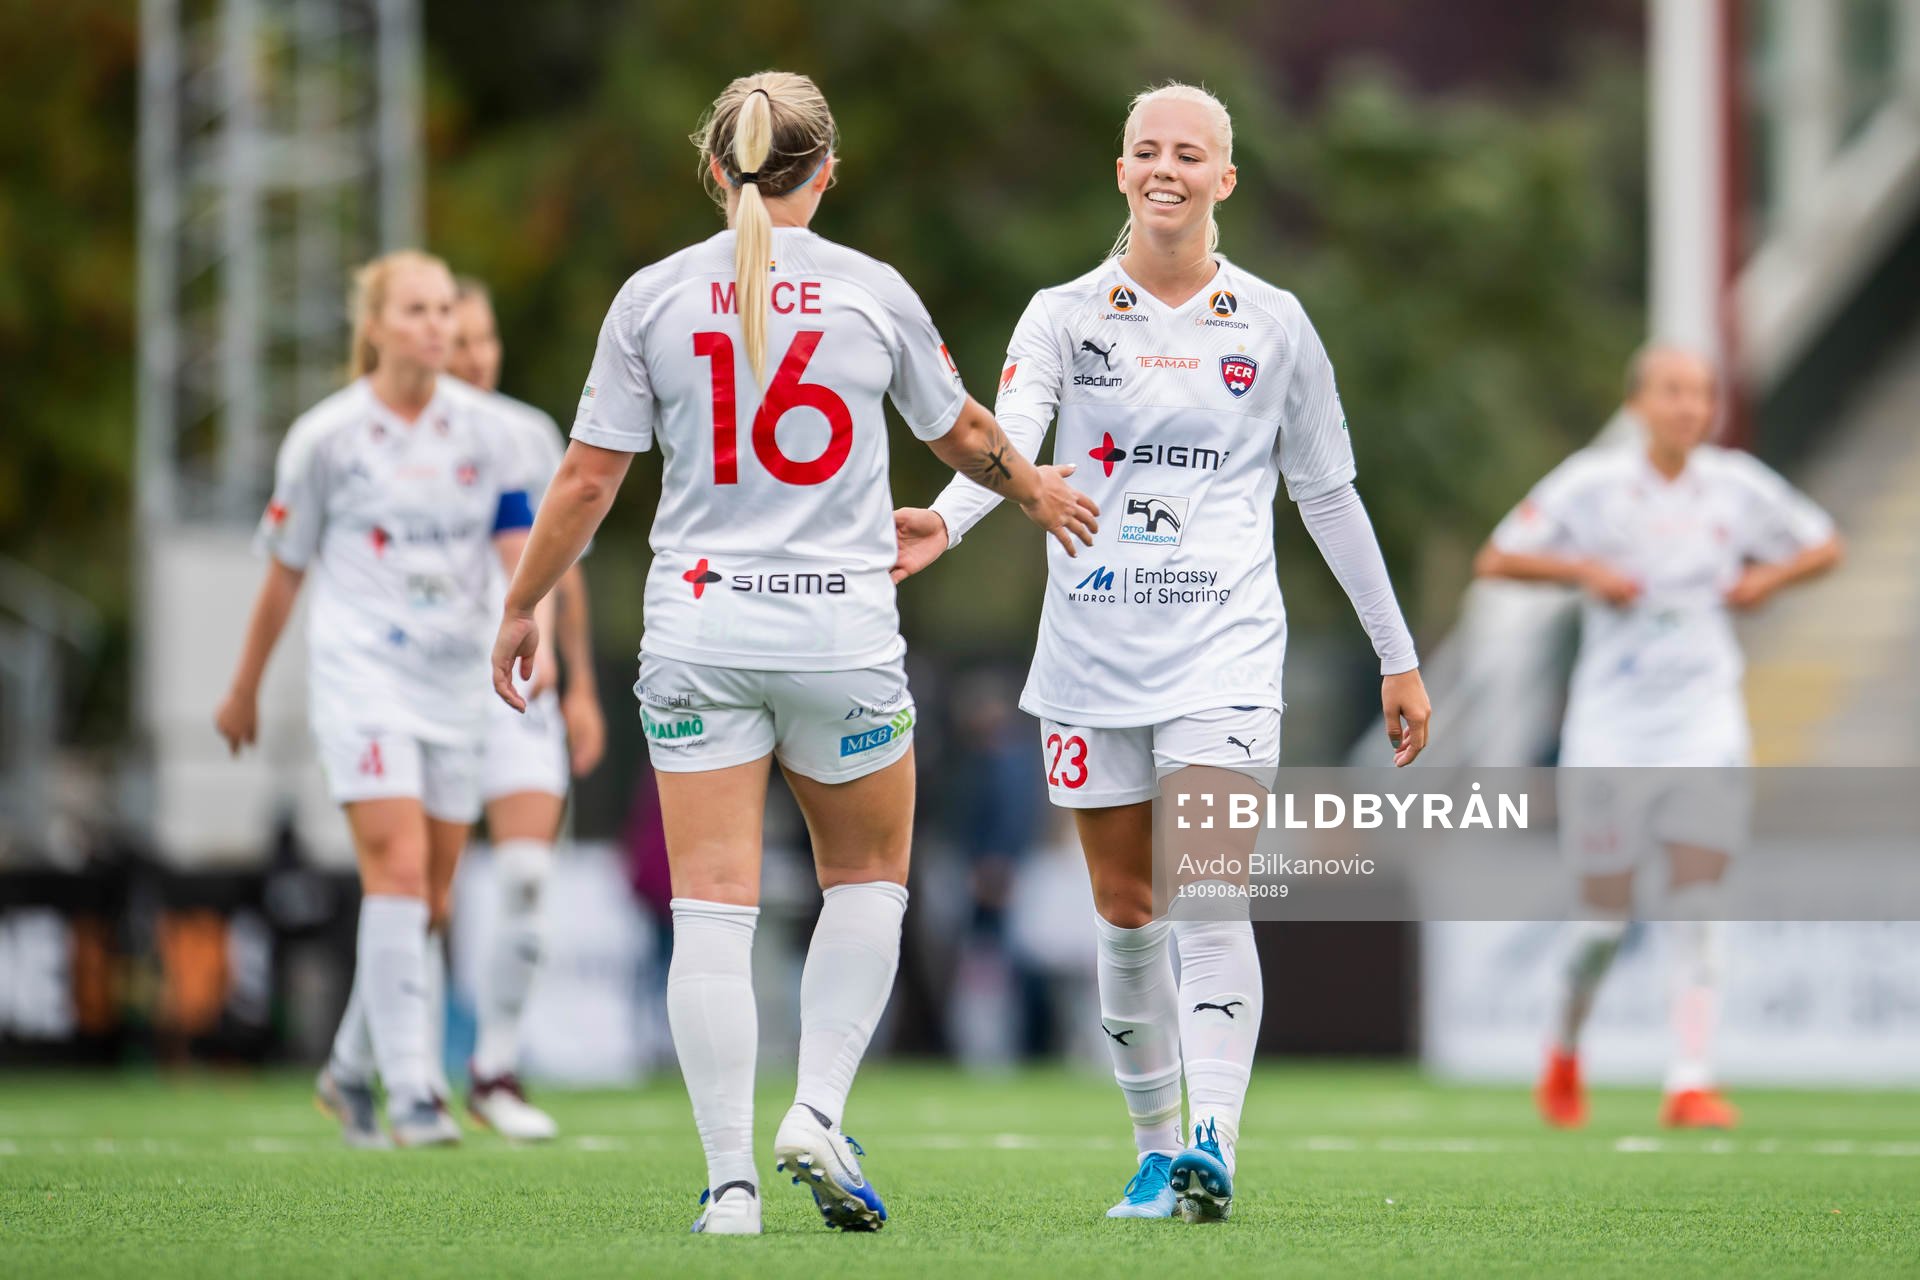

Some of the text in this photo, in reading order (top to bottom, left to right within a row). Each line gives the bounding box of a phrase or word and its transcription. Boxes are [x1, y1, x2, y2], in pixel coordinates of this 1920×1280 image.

[711, 281, 822, 315] MCE
[1136, 355, 1200, 369] TEAMAB
[1225, 364, 1253, 379] FCR
[1073, 374, 1122, 387] stadium
[692, 330, 854, 487] 16
[1121, 533, 1177, 543] MAGNUSSON
[1122, 525, 1145, 534] OTTO
[1135, 567, 1217, 586] Embassy
[1068, 593, 1115, 603] MIDROC
[1134, 586, 1231, 605] of Sharing
[847, 728, 887, 753] MKB
[1047, 733, 1088, 789] 23
